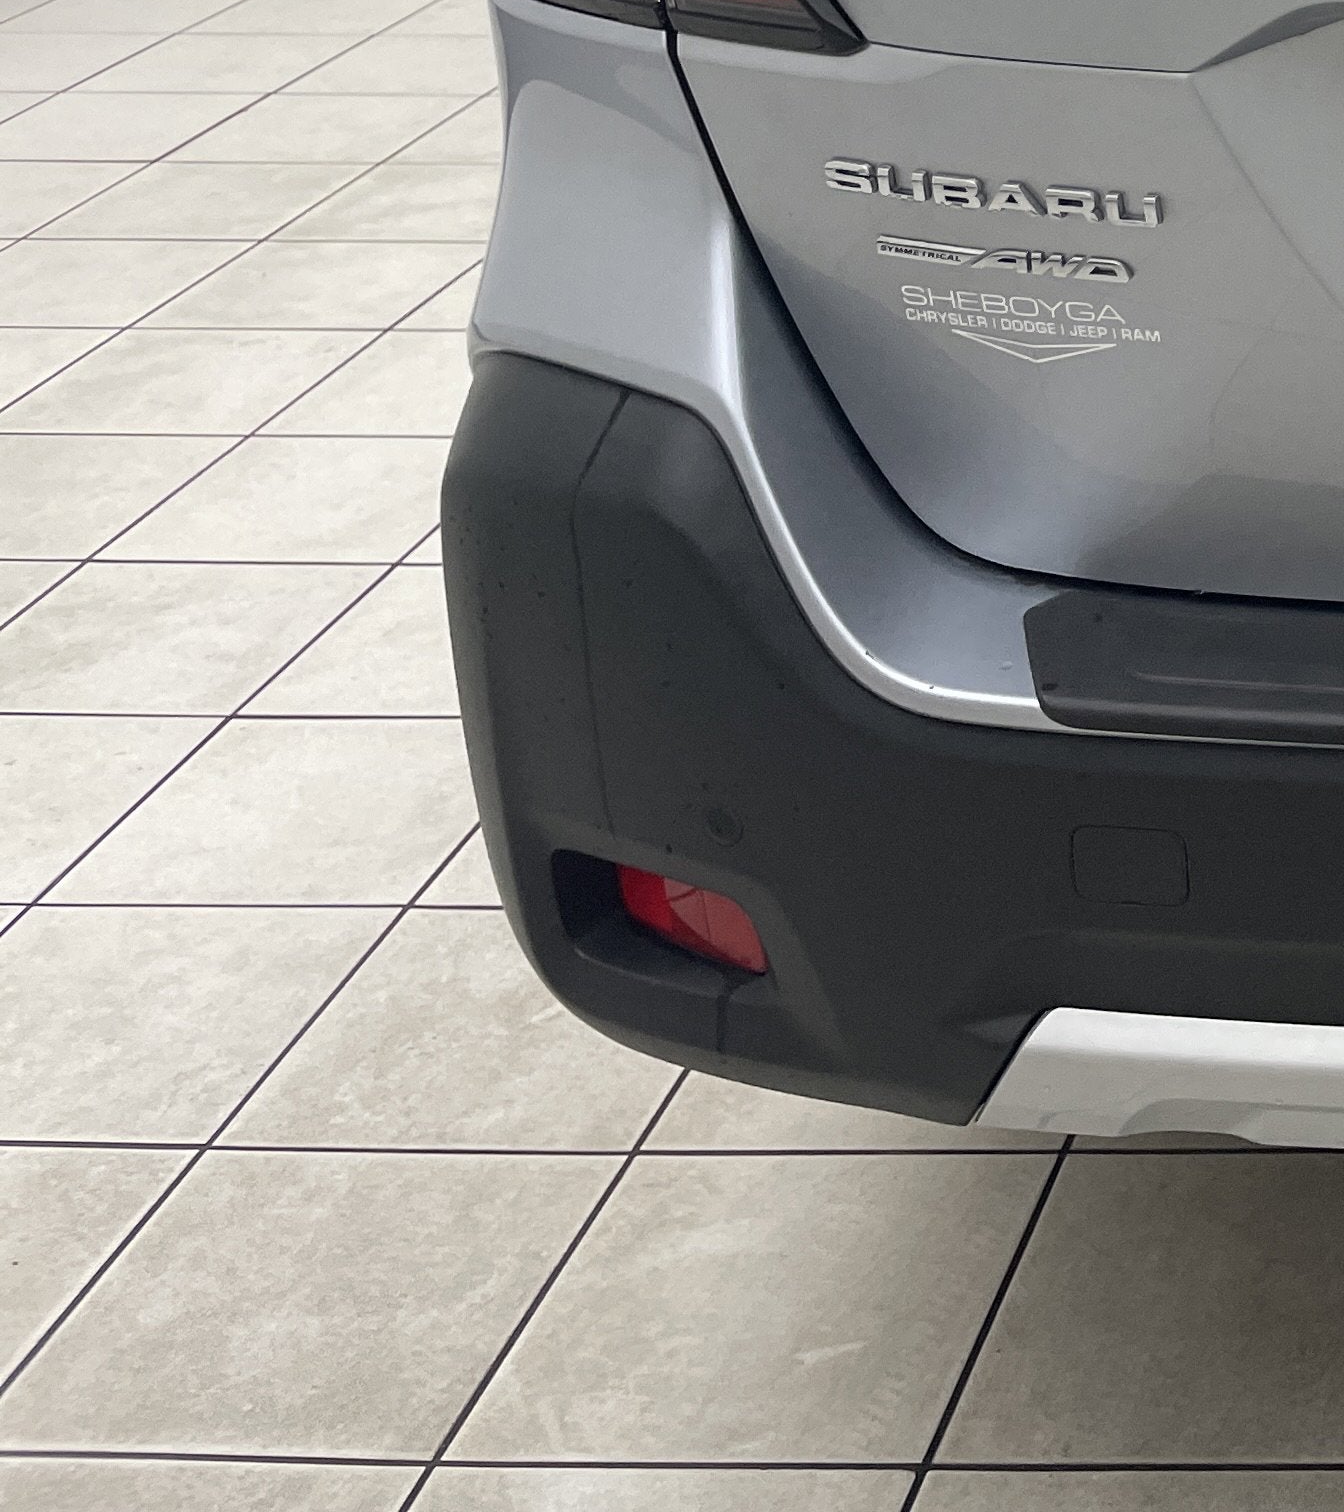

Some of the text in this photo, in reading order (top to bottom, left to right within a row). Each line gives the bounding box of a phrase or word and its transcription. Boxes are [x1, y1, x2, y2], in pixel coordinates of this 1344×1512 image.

[824, 156, 1163, 228] SUBARU
[879, 244, 1135, 284] SYMMETRICAL AWD
[905, 308, 1161, 343] CHRYSLER DODGE JEEP RAM
